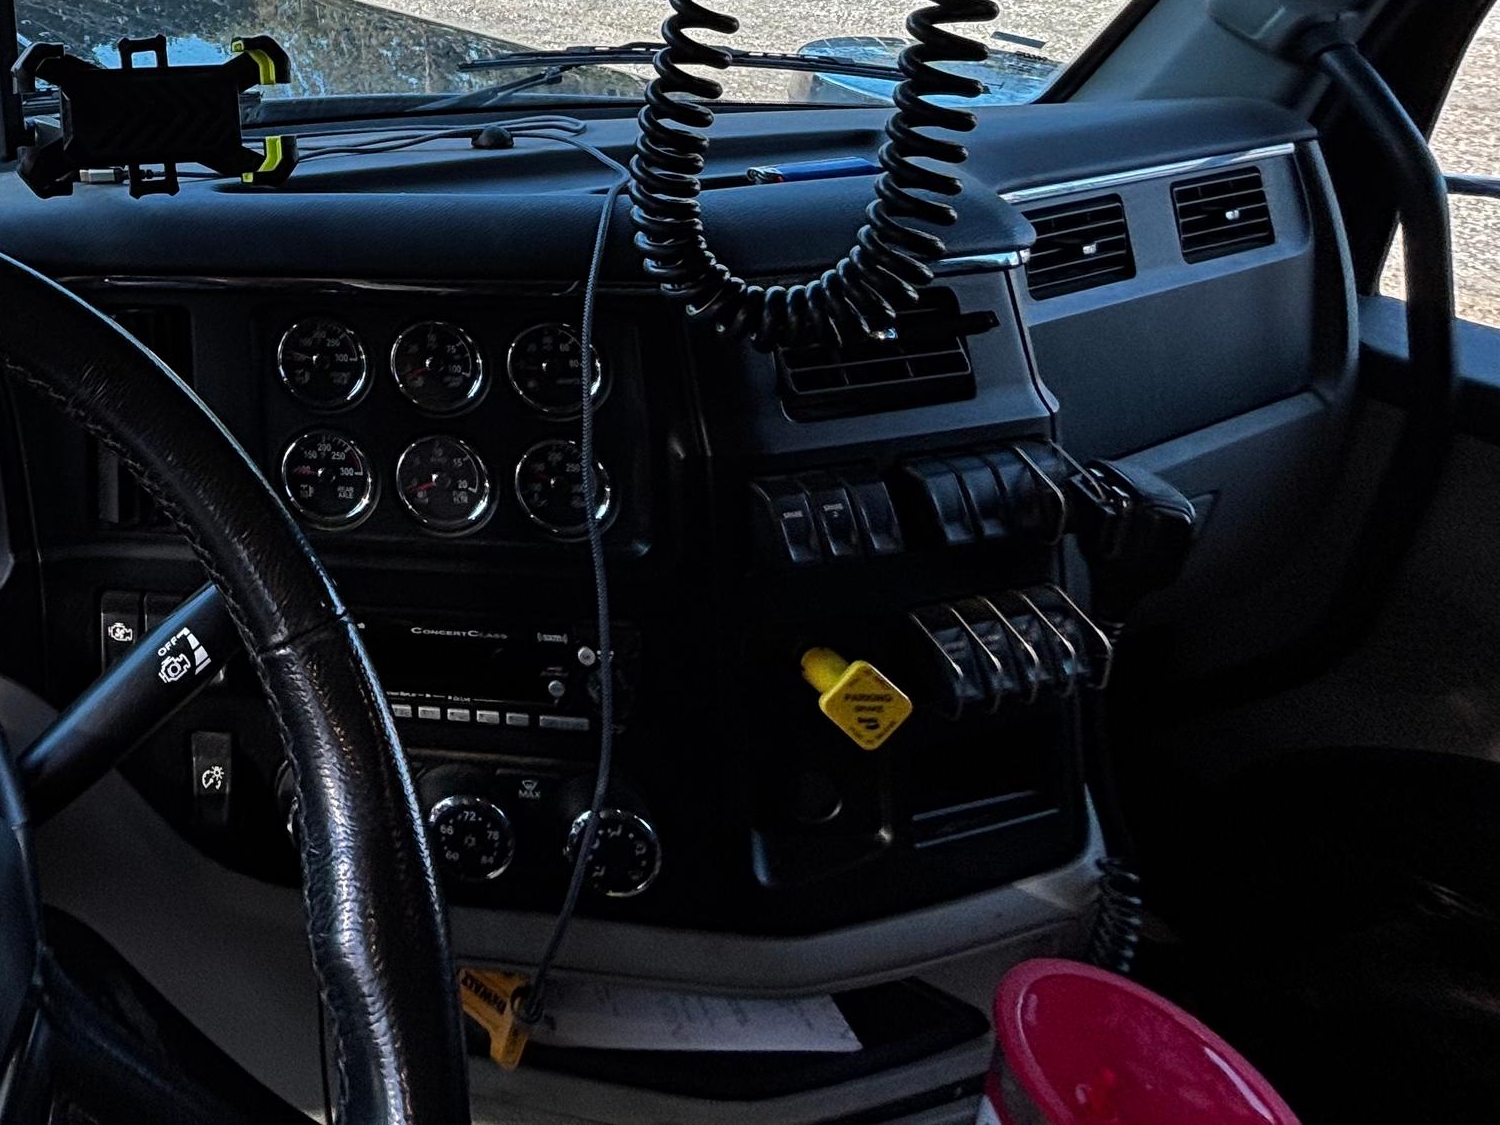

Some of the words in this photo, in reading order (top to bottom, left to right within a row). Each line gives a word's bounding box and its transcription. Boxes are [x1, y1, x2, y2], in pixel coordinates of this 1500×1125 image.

[339, 467, 354, 476] 300
[157, 635, 178, 657] OFF
[463, 811, 477, 822] 72
[439, 825, 455, 835] 66
